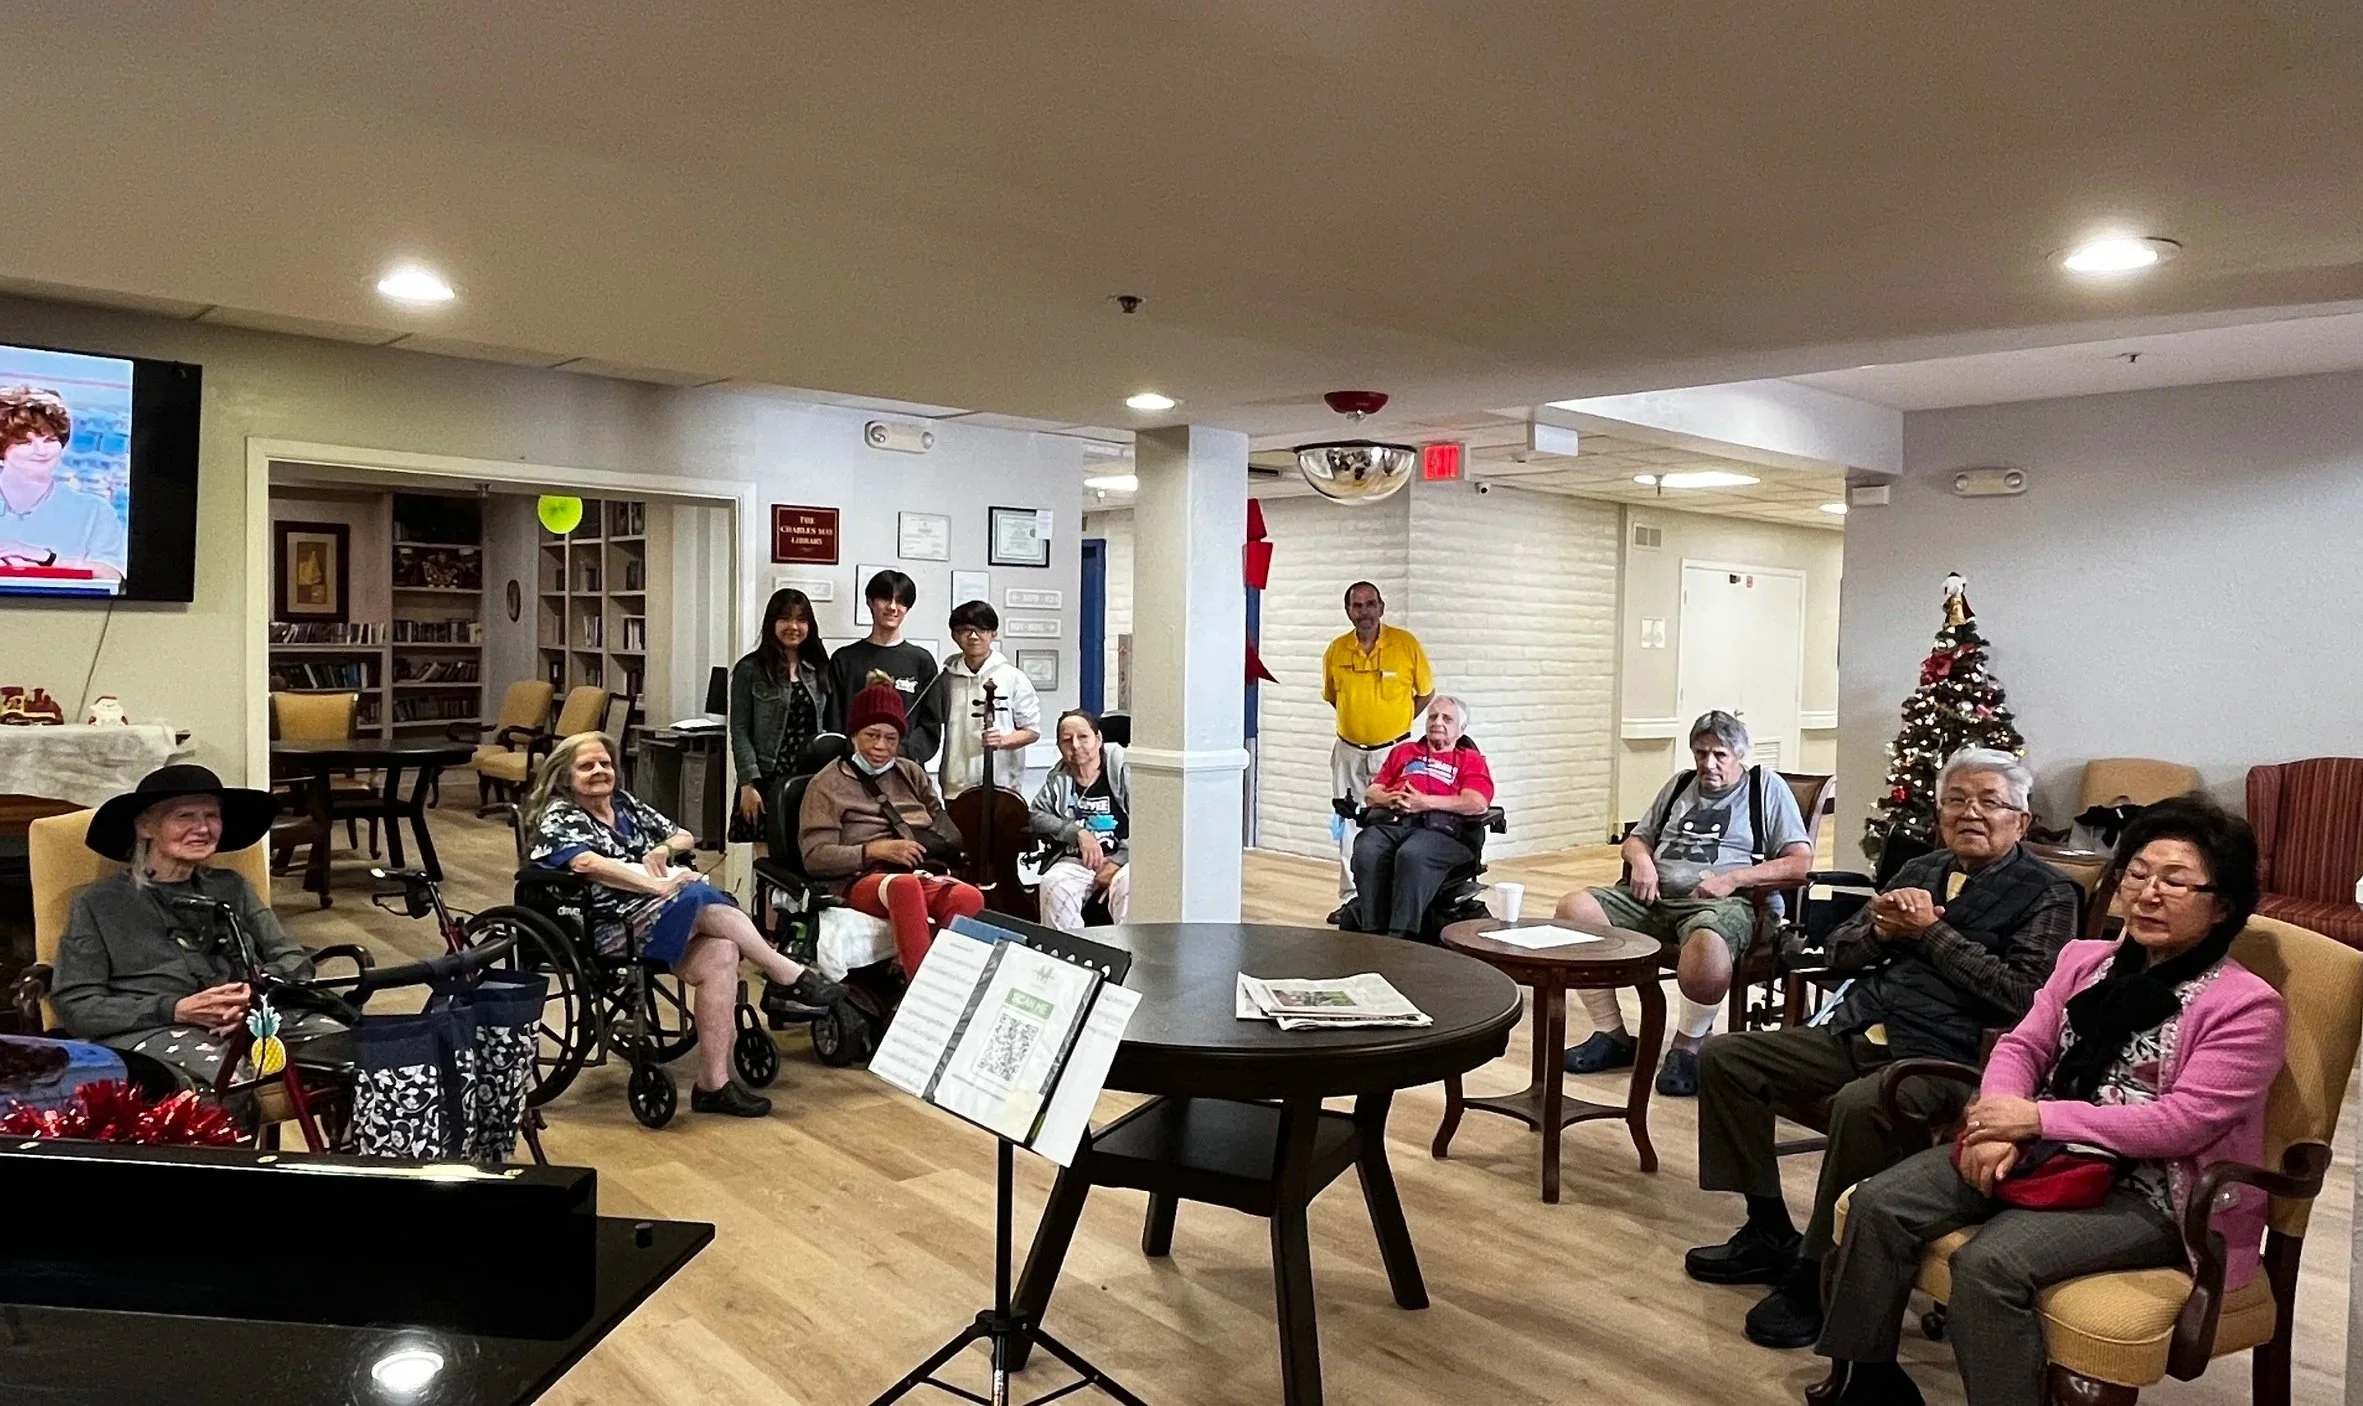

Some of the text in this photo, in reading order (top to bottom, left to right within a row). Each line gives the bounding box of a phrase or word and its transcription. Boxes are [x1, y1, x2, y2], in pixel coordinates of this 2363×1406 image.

[1424, 446, 1459, 480] EXIT
[799, 516, 815, 525] THE
[779, 525, 816, 535] CHARLES
[790, 537, 823, 545] LIBRARY
